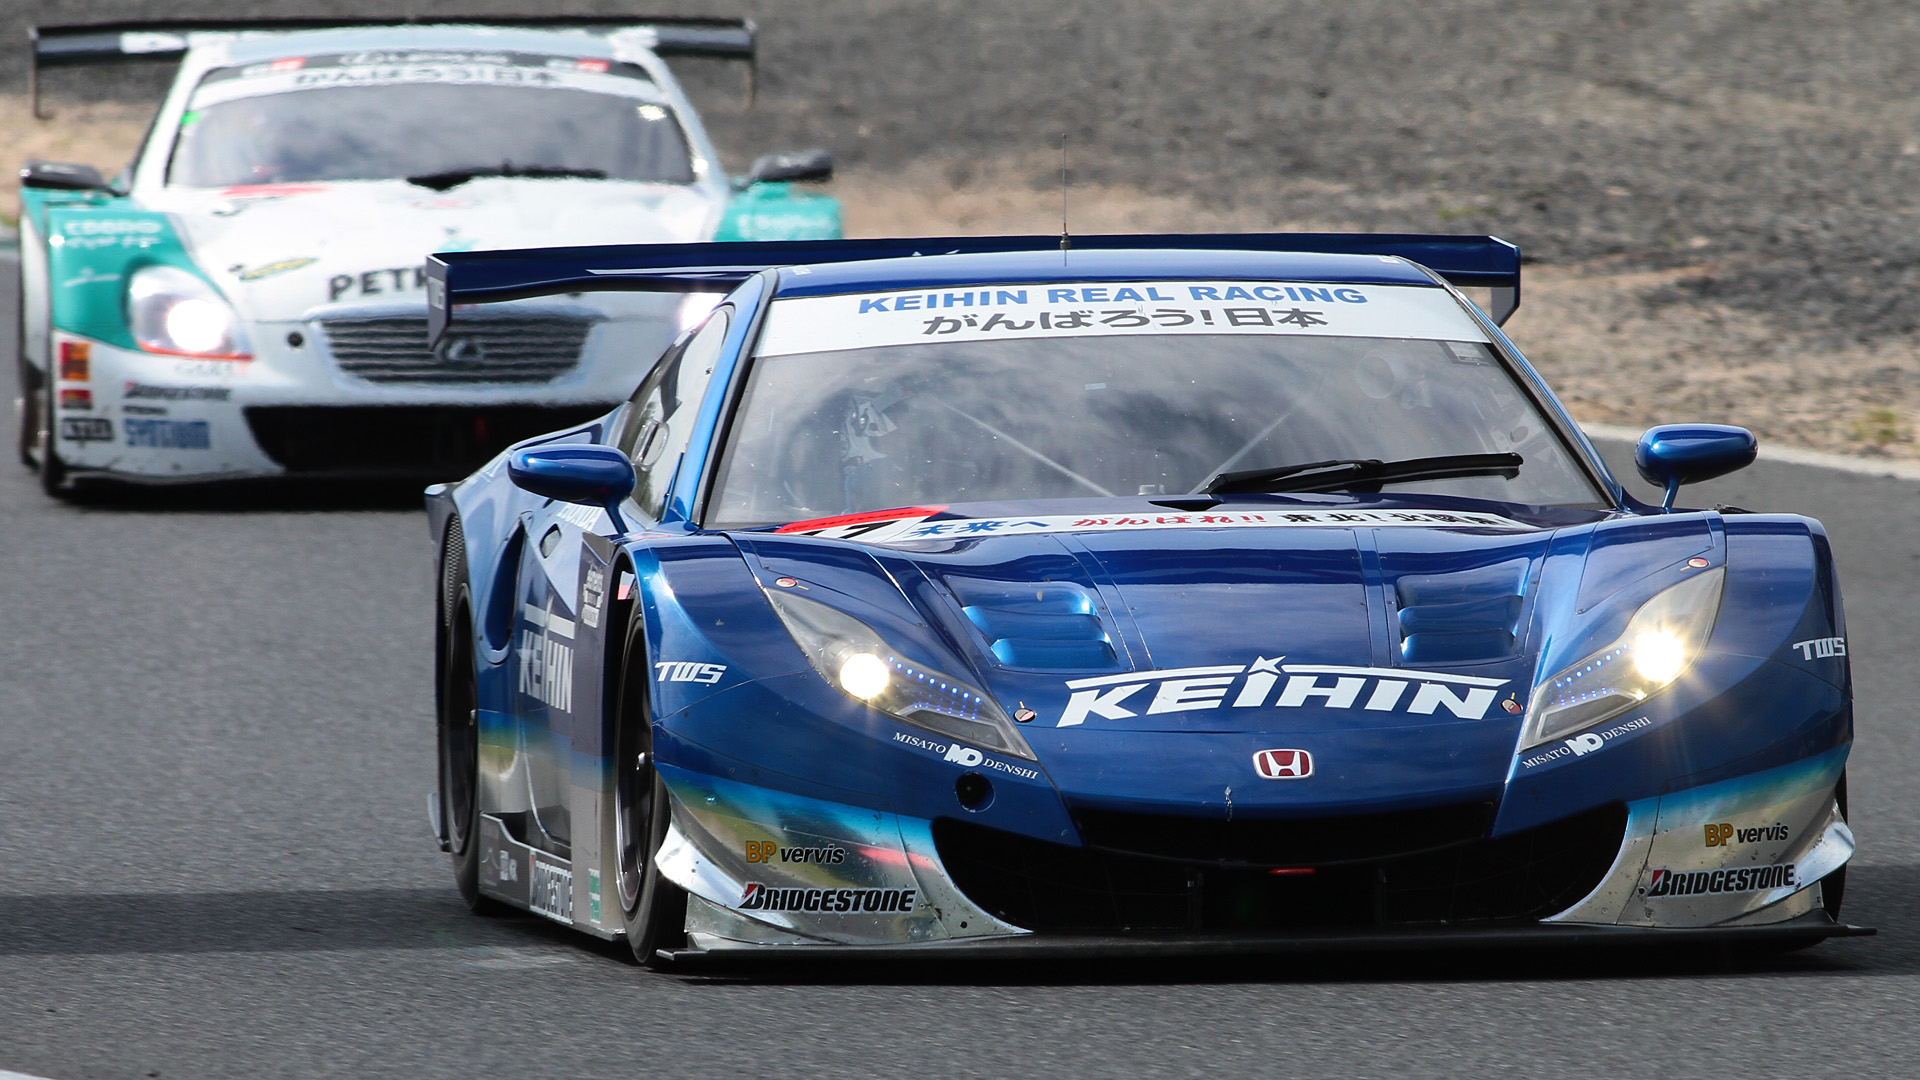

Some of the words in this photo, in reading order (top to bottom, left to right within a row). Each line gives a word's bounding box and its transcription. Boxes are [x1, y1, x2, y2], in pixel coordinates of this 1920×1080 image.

[858, 289, 1028, 314] KEIHIN
[1048, 286, 1176, 304] REAL
[1190, 286, 1368, 304] RACING
[923, 308, 1328, 334] がんばろう!日本
[1071, 514, 1268, 527] がんばれ!!
[1792, 637, 1846, 662] TWS
[519, 628, 574, 714] KEIHIN
[654, 661, 728, 684] TWS
[1056, 664, 1500, 728] KEIHIN
[892, 731, 946, 754] MISATO
[982, 758, 1039, 781] DENSHI
[1522, 745, 1571, 769] MISATO
[1603, 716, 1652, 742] DENSHI
[1703, 823, 1734, 848] BP
[1737, 822, 1789, 844] vervis
[745, 841, 776, 864] BP
[780, 843, 846, 864] vervis
[1647, 864, 1796, 898] BRIDGESTONE
[737, 881, 917, 914] BRIDGESTONE
